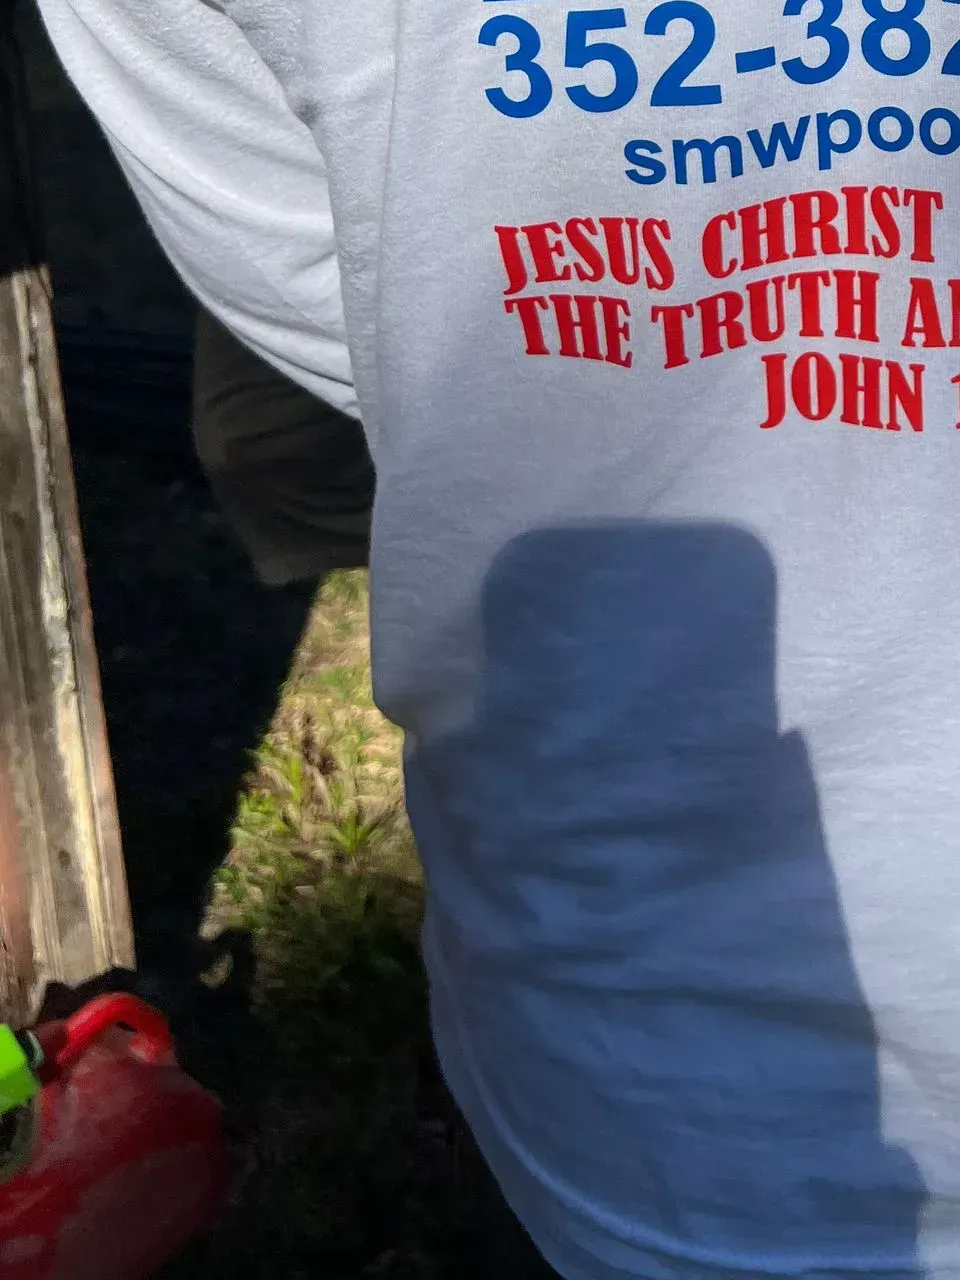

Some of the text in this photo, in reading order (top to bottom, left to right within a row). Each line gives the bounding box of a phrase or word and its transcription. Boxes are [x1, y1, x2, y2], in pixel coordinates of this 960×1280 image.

[495, 217, 674, 296] JESUS
[701, 186, 943, 279] CHRIST
[504, 294, 631, 368] THE
[651, 269, 880, 369] TRUTH
[761, 352, 925, 432] JOHN
